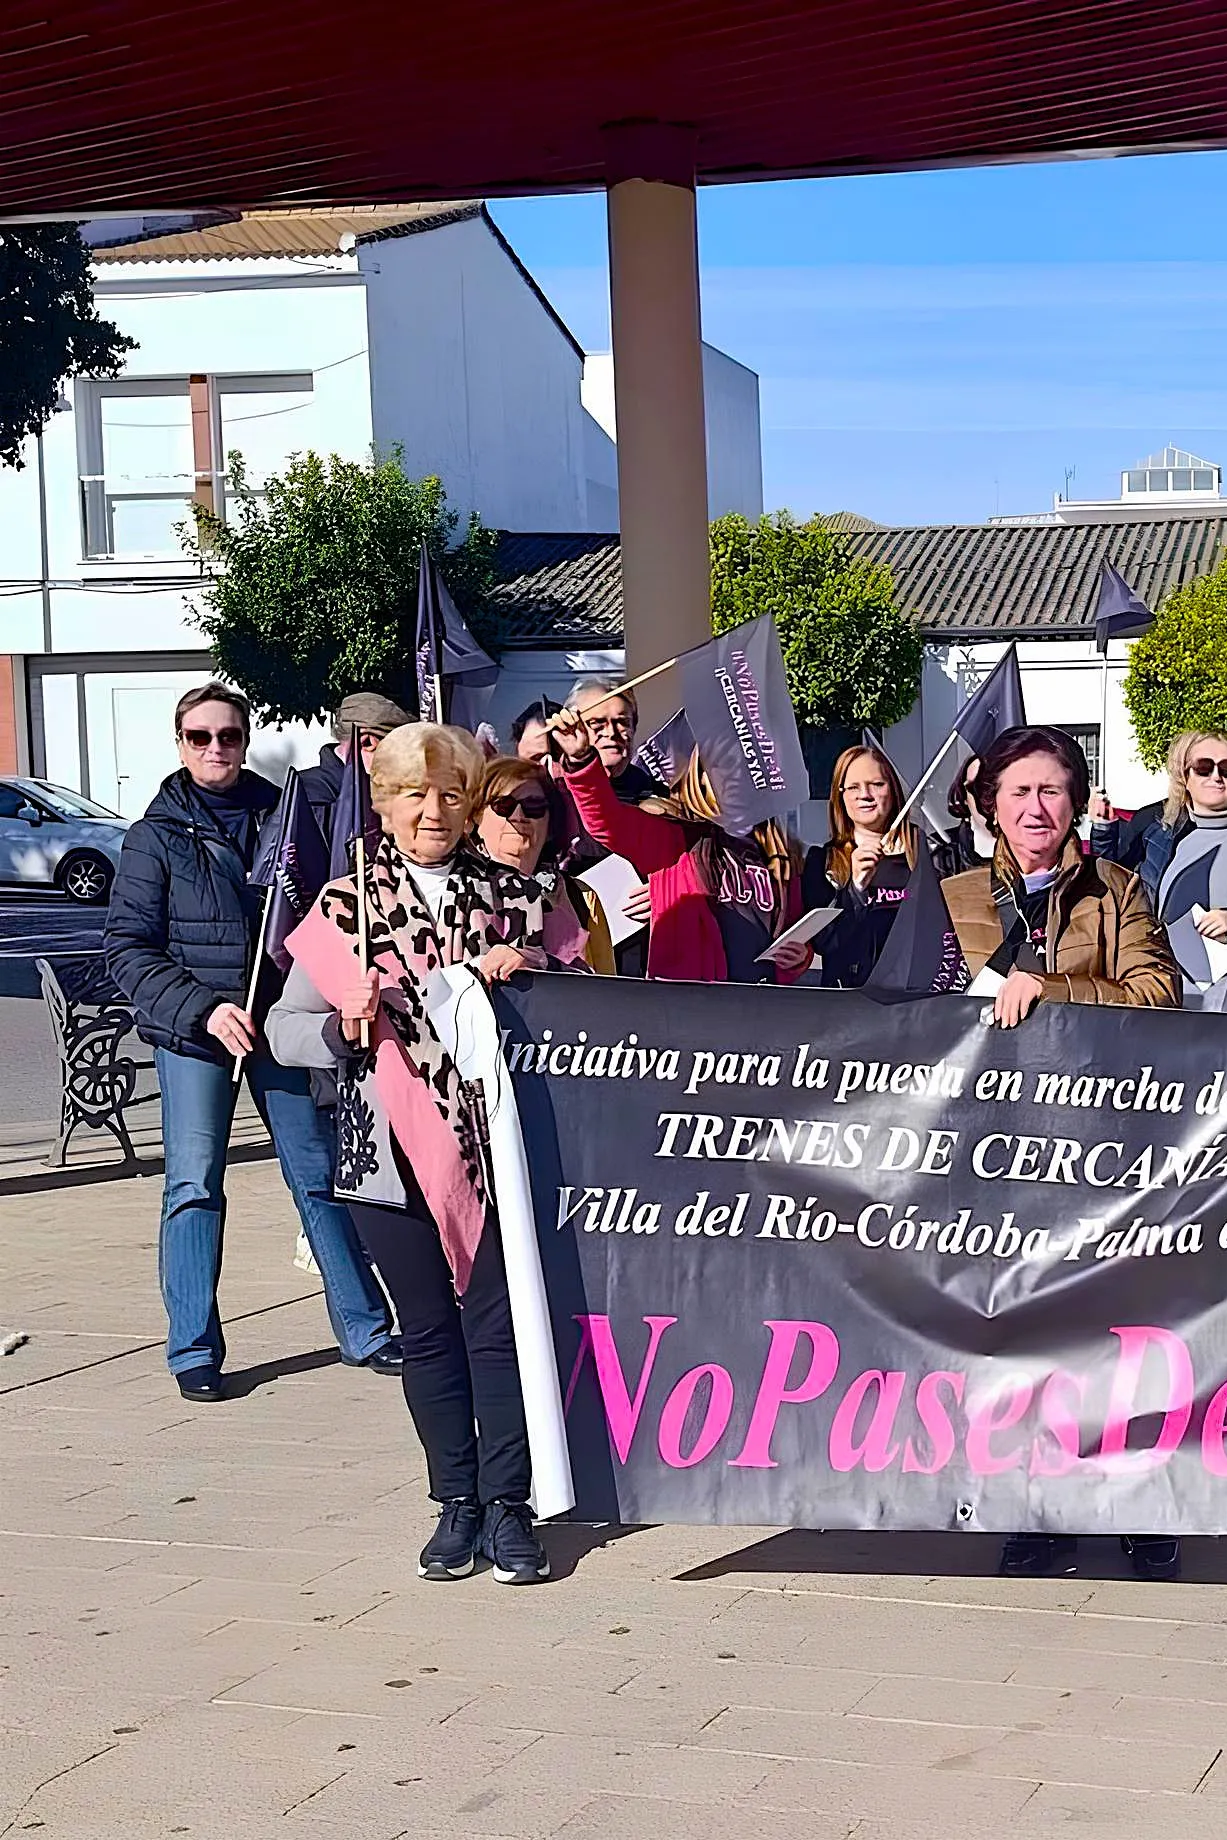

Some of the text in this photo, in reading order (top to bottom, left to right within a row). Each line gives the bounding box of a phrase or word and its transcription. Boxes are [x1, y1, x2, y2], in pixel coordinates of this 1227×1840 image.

[683, 1046, 779, 1094] para
[791, 1043, 830, 1089] la
[833, 1054, 964, 1104] puesta
[975, 1068, 1022, 1101] en
[1034, 1065, 1186, 1114] marcha
[654, 1111, 871, 1169] TRENES
[877, 1125, 960, 1176] DE
[555, 1185, 661, 1236] Villa
[674, 1192, 750, 1238] del
